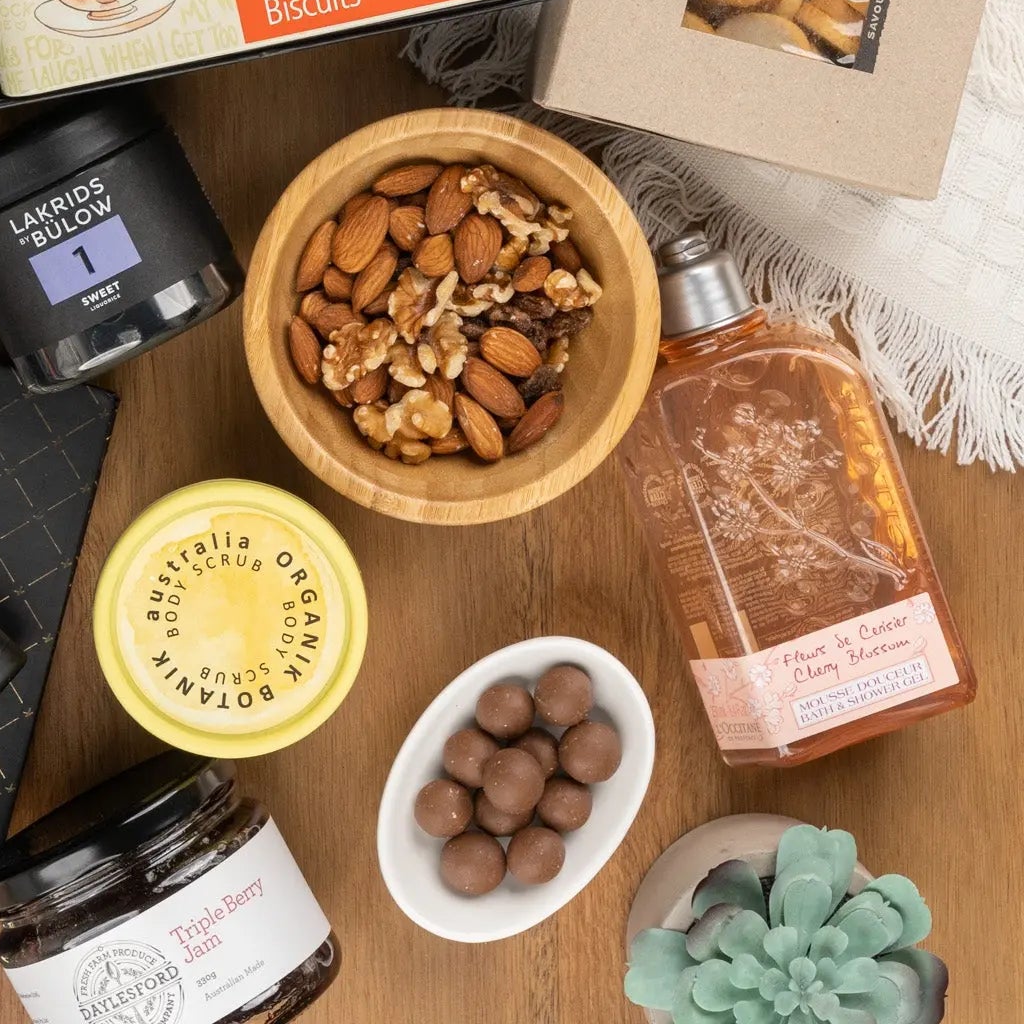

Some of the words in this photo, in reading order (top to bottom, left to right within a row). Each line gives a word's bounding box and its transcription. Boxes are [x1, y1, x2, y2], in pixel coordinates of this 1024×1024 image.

[9, 177, 104, 235] LAKRIDS
[19, 236, 30, 246] BY
[31, 196, 113, 248] BÜLOW
[72, 245, 95, 275] 1
[81, 281, 121, 306] SWEET
[146, 532, 250, 621] australia
[192, 553, 262, 577] SCRUB
[165, 580, 187, 638] BODY
[275, 551, 321, 682] ORGANIK
[275, 600, 296, 659] BODY
[151, 650, 275, 710] BOTANIK
[200, 662, 270, 684] SCRUB
[794, 663, 839, 684] Cherry
[849, 639, 911, 666] Blossom
[799, 684, 856, 712] MOUSSE
[856, 662, 923, 691] DOUCEUR
[800, 704, 835, 725] BATH
[837, 701, 845, 712] &
[847, 681, 900, 709] SHOWER
[903, 673, 928, 689] GEL
[169, 907, 225, 945] Triple
[221, 878, 263, 914] Berry
[80, 969, 92, 996] FRESH
[88, 952, 111, 970] FARM
[113, 949, 157, 965] PRODUCE
[184, 934, 223, 964] Jam
[80, 964, 179, 1021] DAYLESFORD
[196, 971, 217, 988] 330g
[204, 974, 244, 1001] Australian
[244, 960, 265, 974] Made
